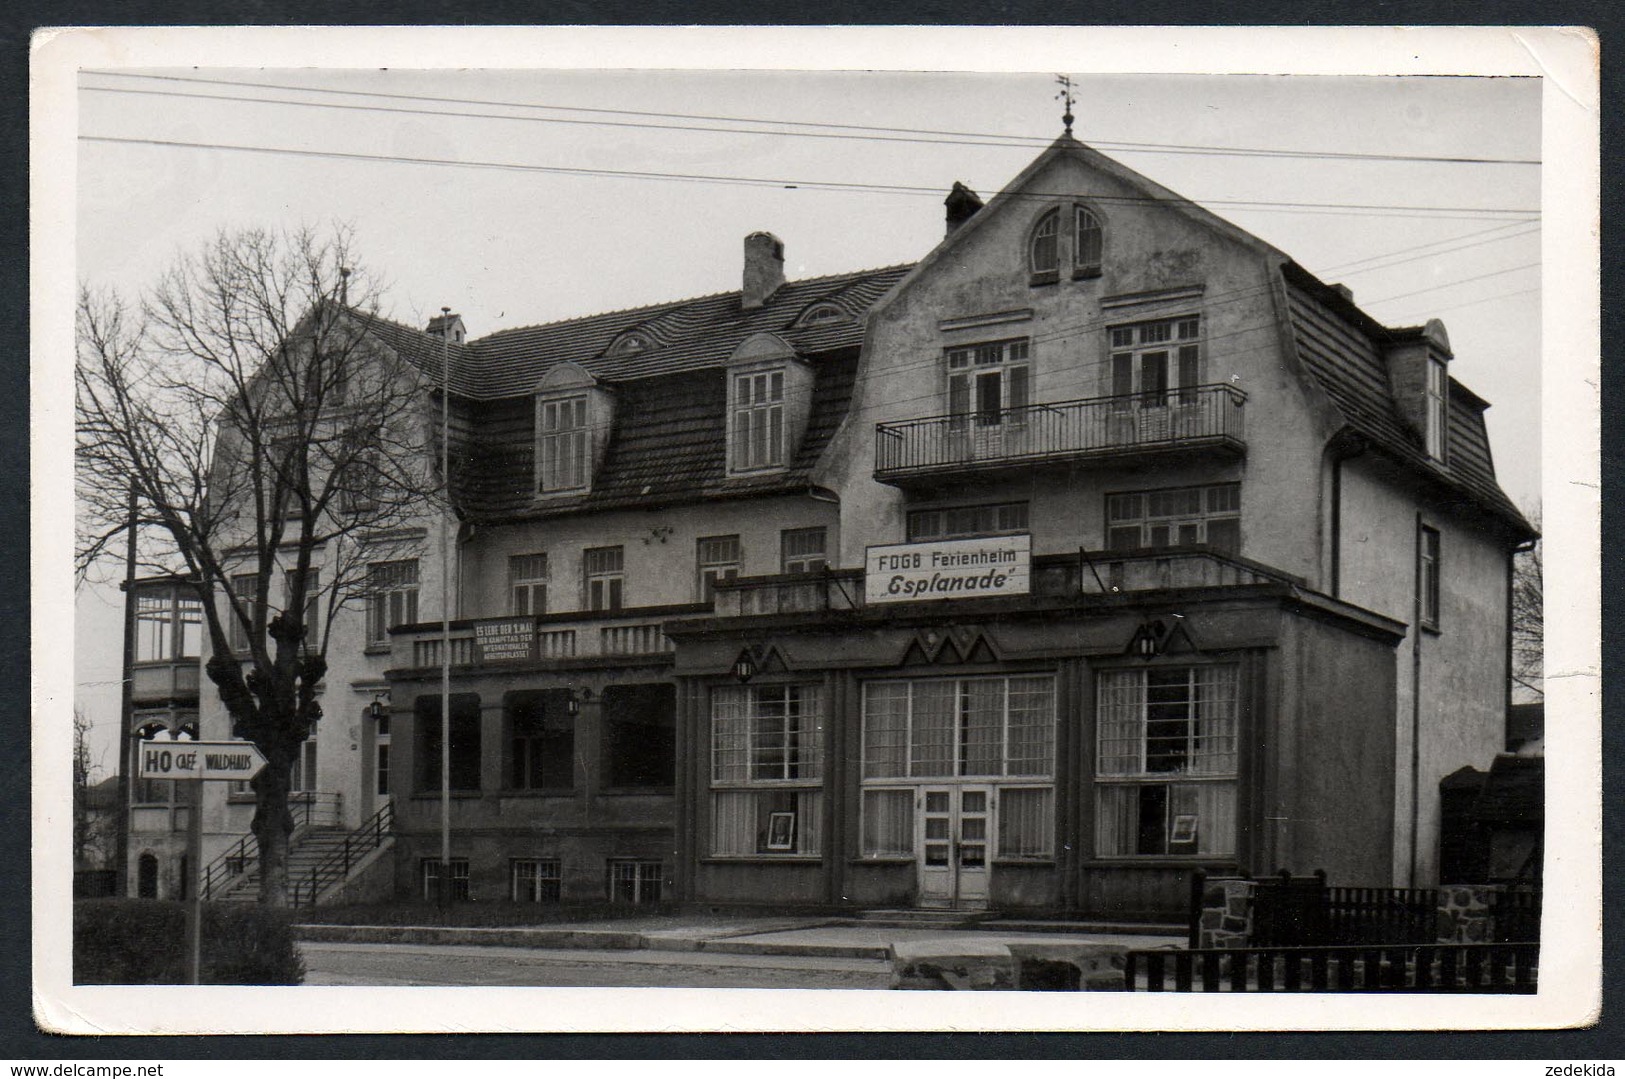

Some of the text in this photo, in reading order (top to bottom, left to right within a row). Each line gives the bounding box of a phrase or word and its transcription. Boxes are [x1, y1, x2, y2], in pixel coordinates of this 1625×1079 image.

[879, 548, 1016, 571] FDGB Ferienheim
[476, 626, 484, 637] ES
[484, 625, 499, 636] LEBE
[145, 750, 252, 773] HO CAFÉ WALDHAUS
